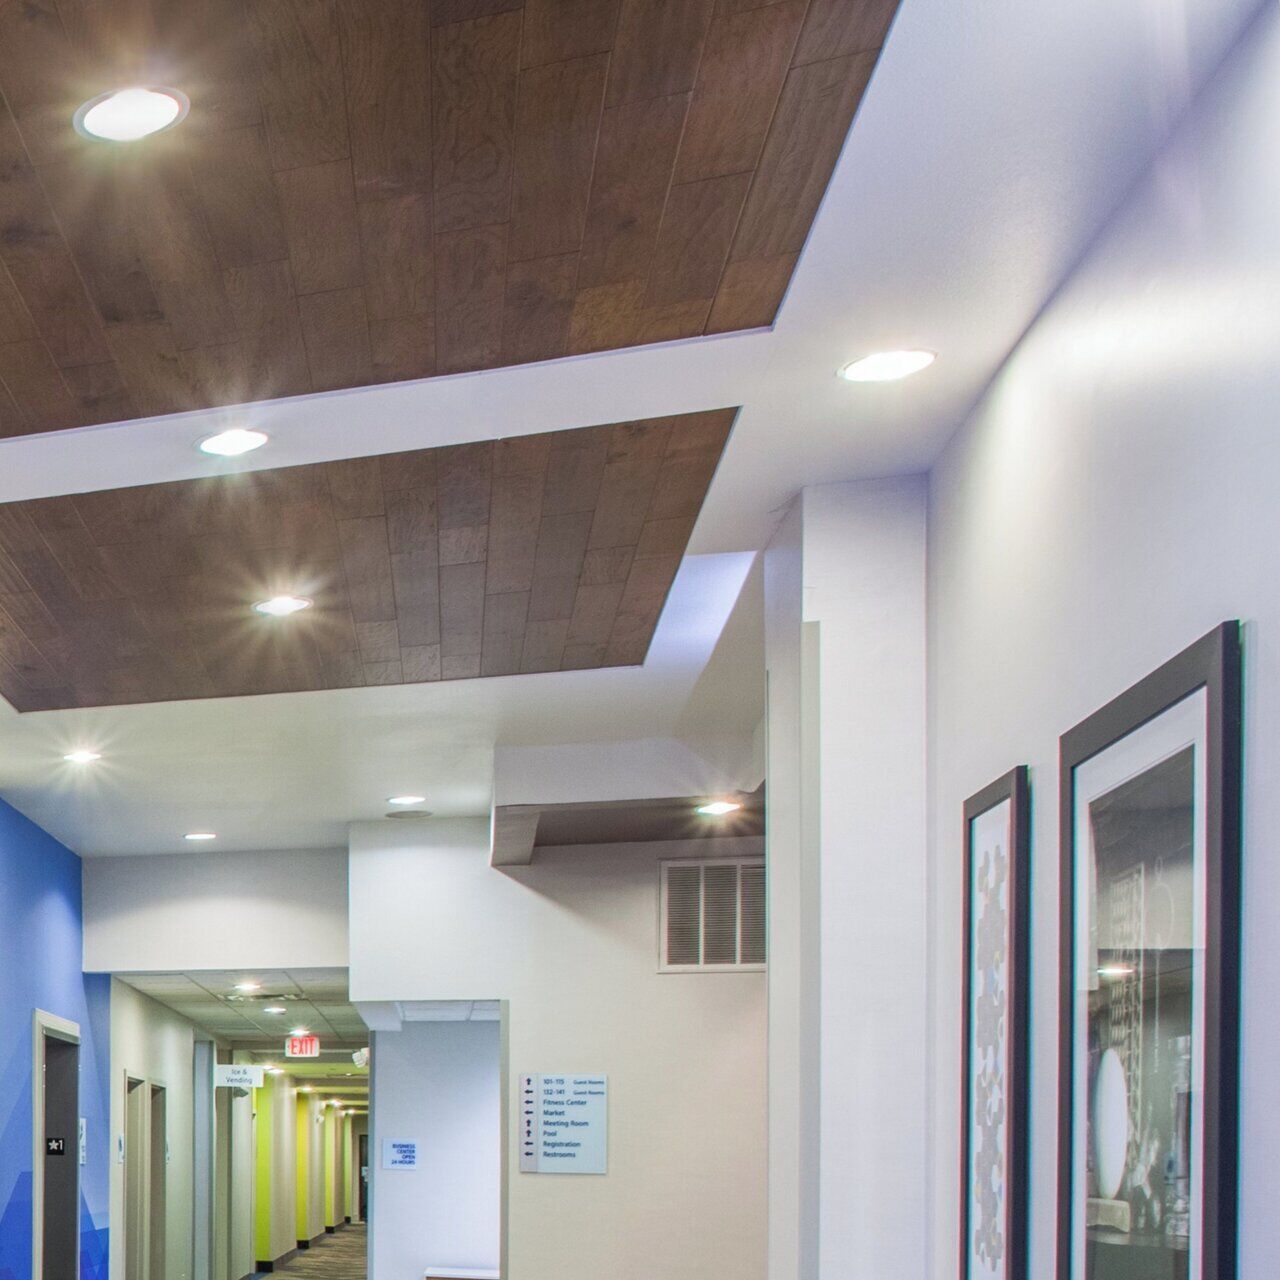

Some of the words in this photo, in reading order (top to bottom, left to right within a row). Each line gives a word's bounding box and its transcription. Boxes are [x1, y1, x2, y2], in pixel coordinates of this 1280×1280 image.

[291, 1037, 315, 1055] EXIT
[226, 1077, 253, 1085] Vending
[543, 1120, 569, 1128] Meeting
[543, 1140, 581, 1148] Registration
